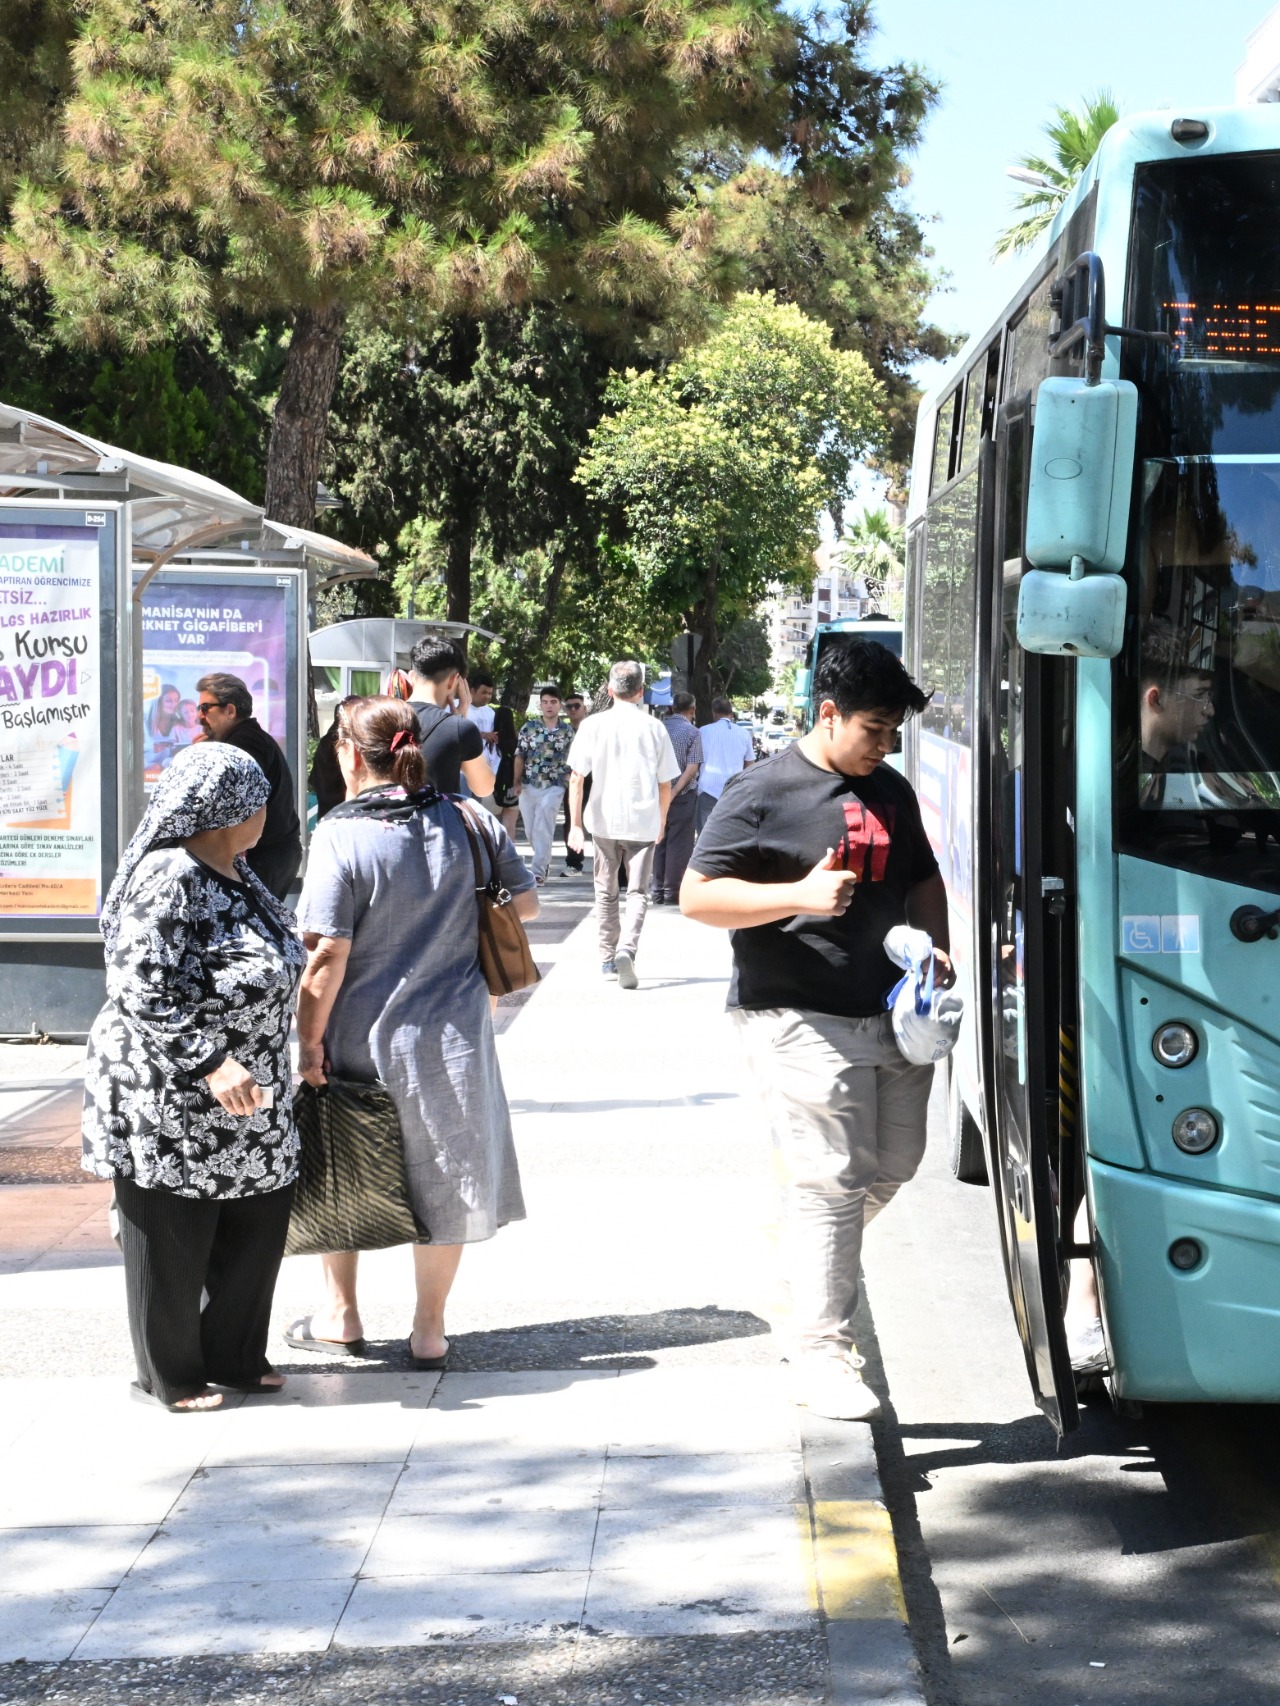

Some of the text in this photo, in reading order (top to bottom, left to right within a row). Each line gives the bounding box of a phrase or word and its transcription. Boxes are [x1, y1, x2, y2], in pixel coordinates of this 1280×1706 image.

[34, 576, 92, 587] ÖĞRENCİMİZE
[1, 607, 92, 628] LGS HAZIRLIK
[142, 605, 242, 620] MANİSA'NIN DA
[183, 618, 263, 633] GİGAFİBER'İ
[15, 630, 88, 660] Kursu
[178, 634, 206, 645] VAR
[1, 704, 91, 730] Başlamıştır
